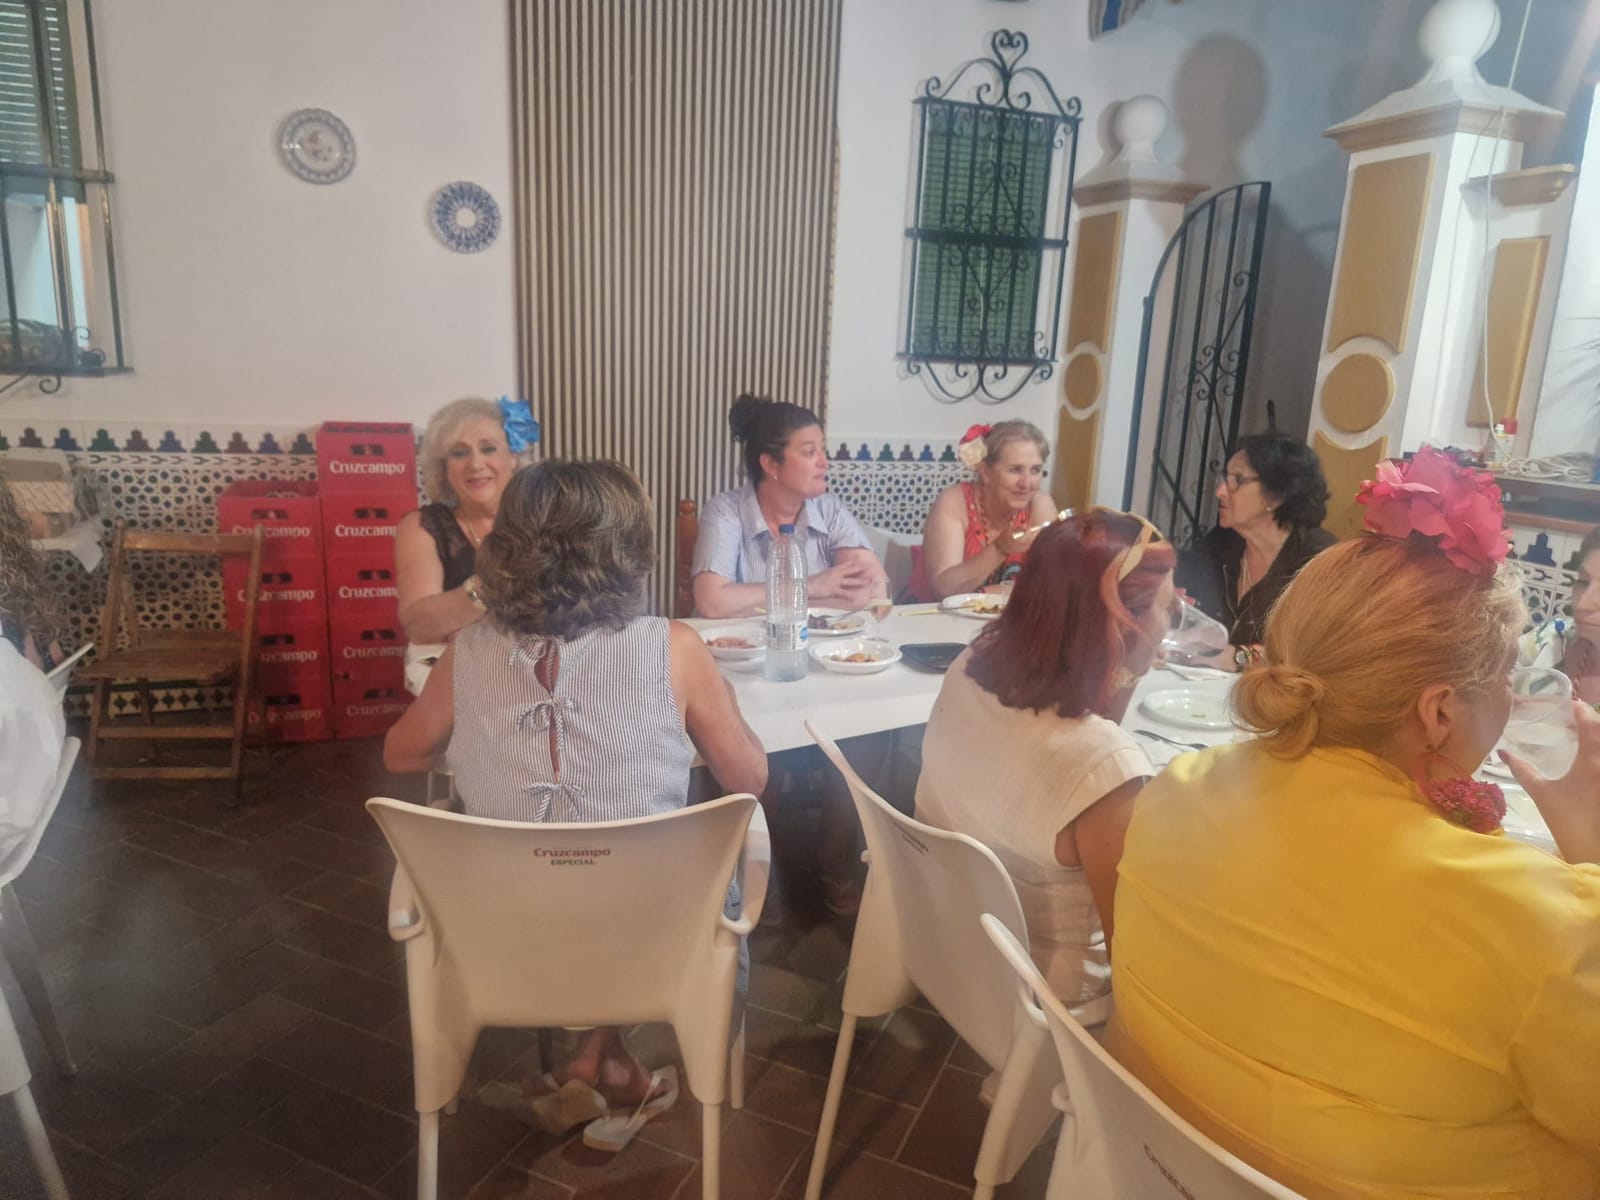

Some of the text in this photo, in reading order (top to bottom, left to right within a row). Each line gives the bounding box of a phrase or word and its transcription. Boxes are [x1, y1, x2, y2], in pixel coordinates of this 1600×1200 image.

[329, 460, 405, 476] Cruzcampo
[335, 523, 397, 537] Cruzcam
[339, 585, 399, 599] Cruzcam
[533, 847, 611, 858] Cruzcampo
[550, 858, 596, 866] ESPECIAL
